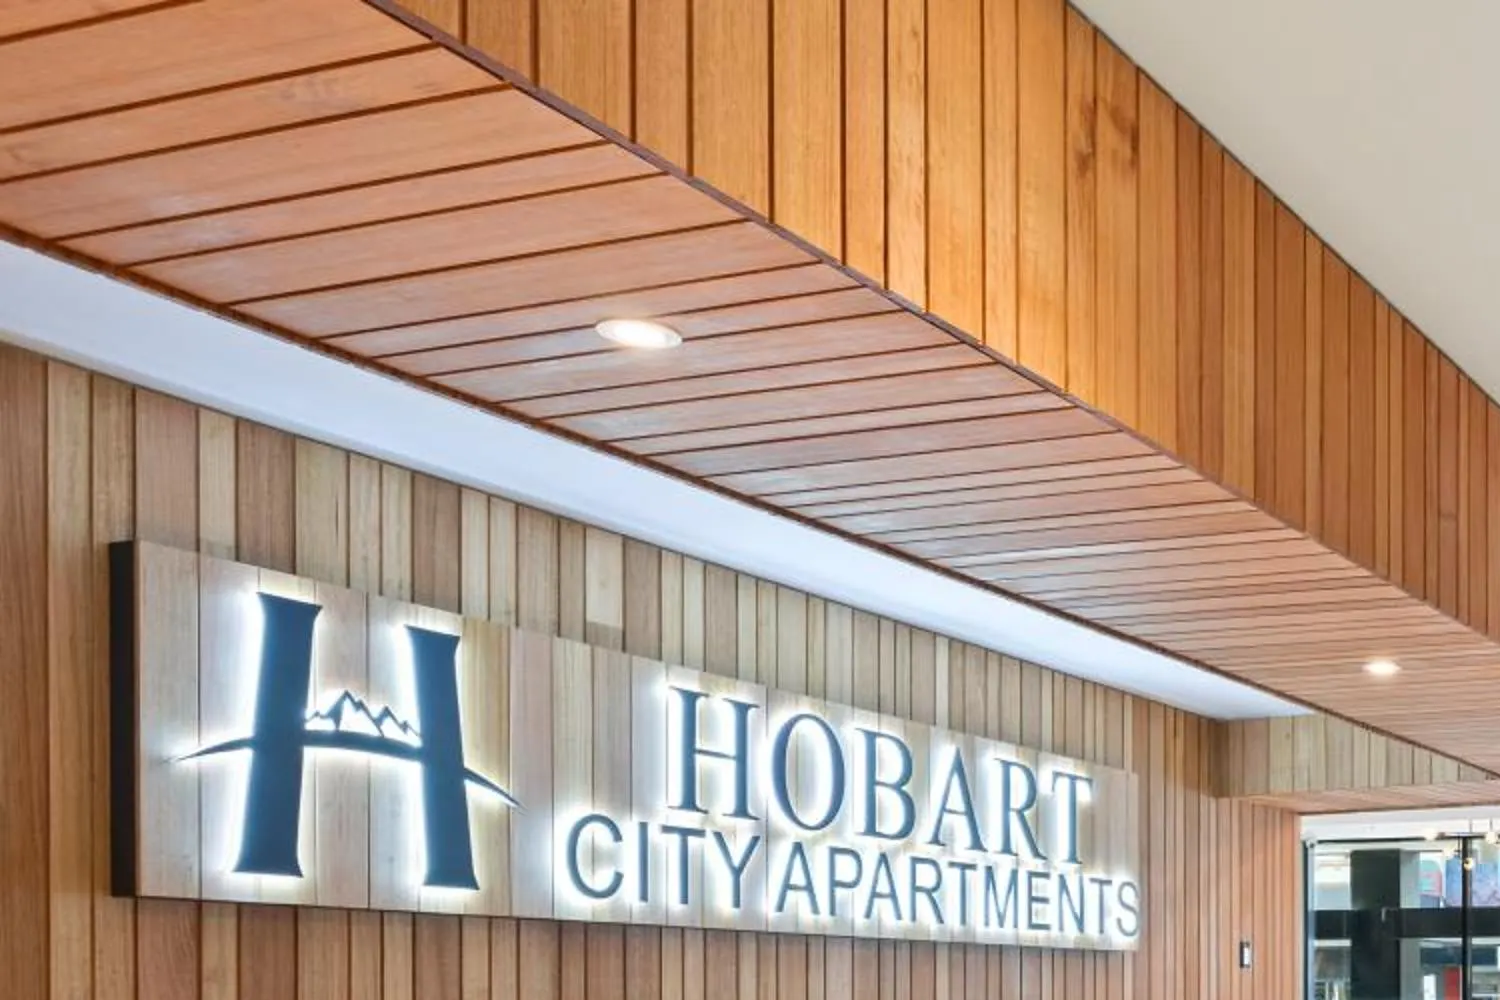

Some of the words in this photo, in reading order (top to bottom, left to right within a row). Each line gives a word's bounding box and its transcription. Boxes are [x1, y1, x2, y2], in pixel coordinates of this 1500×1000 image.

[667, 685, 1093, 865] HOBART
[566, 813, 761, 909] CITY
[774, 840, 1140, 937] APARTMENTS
